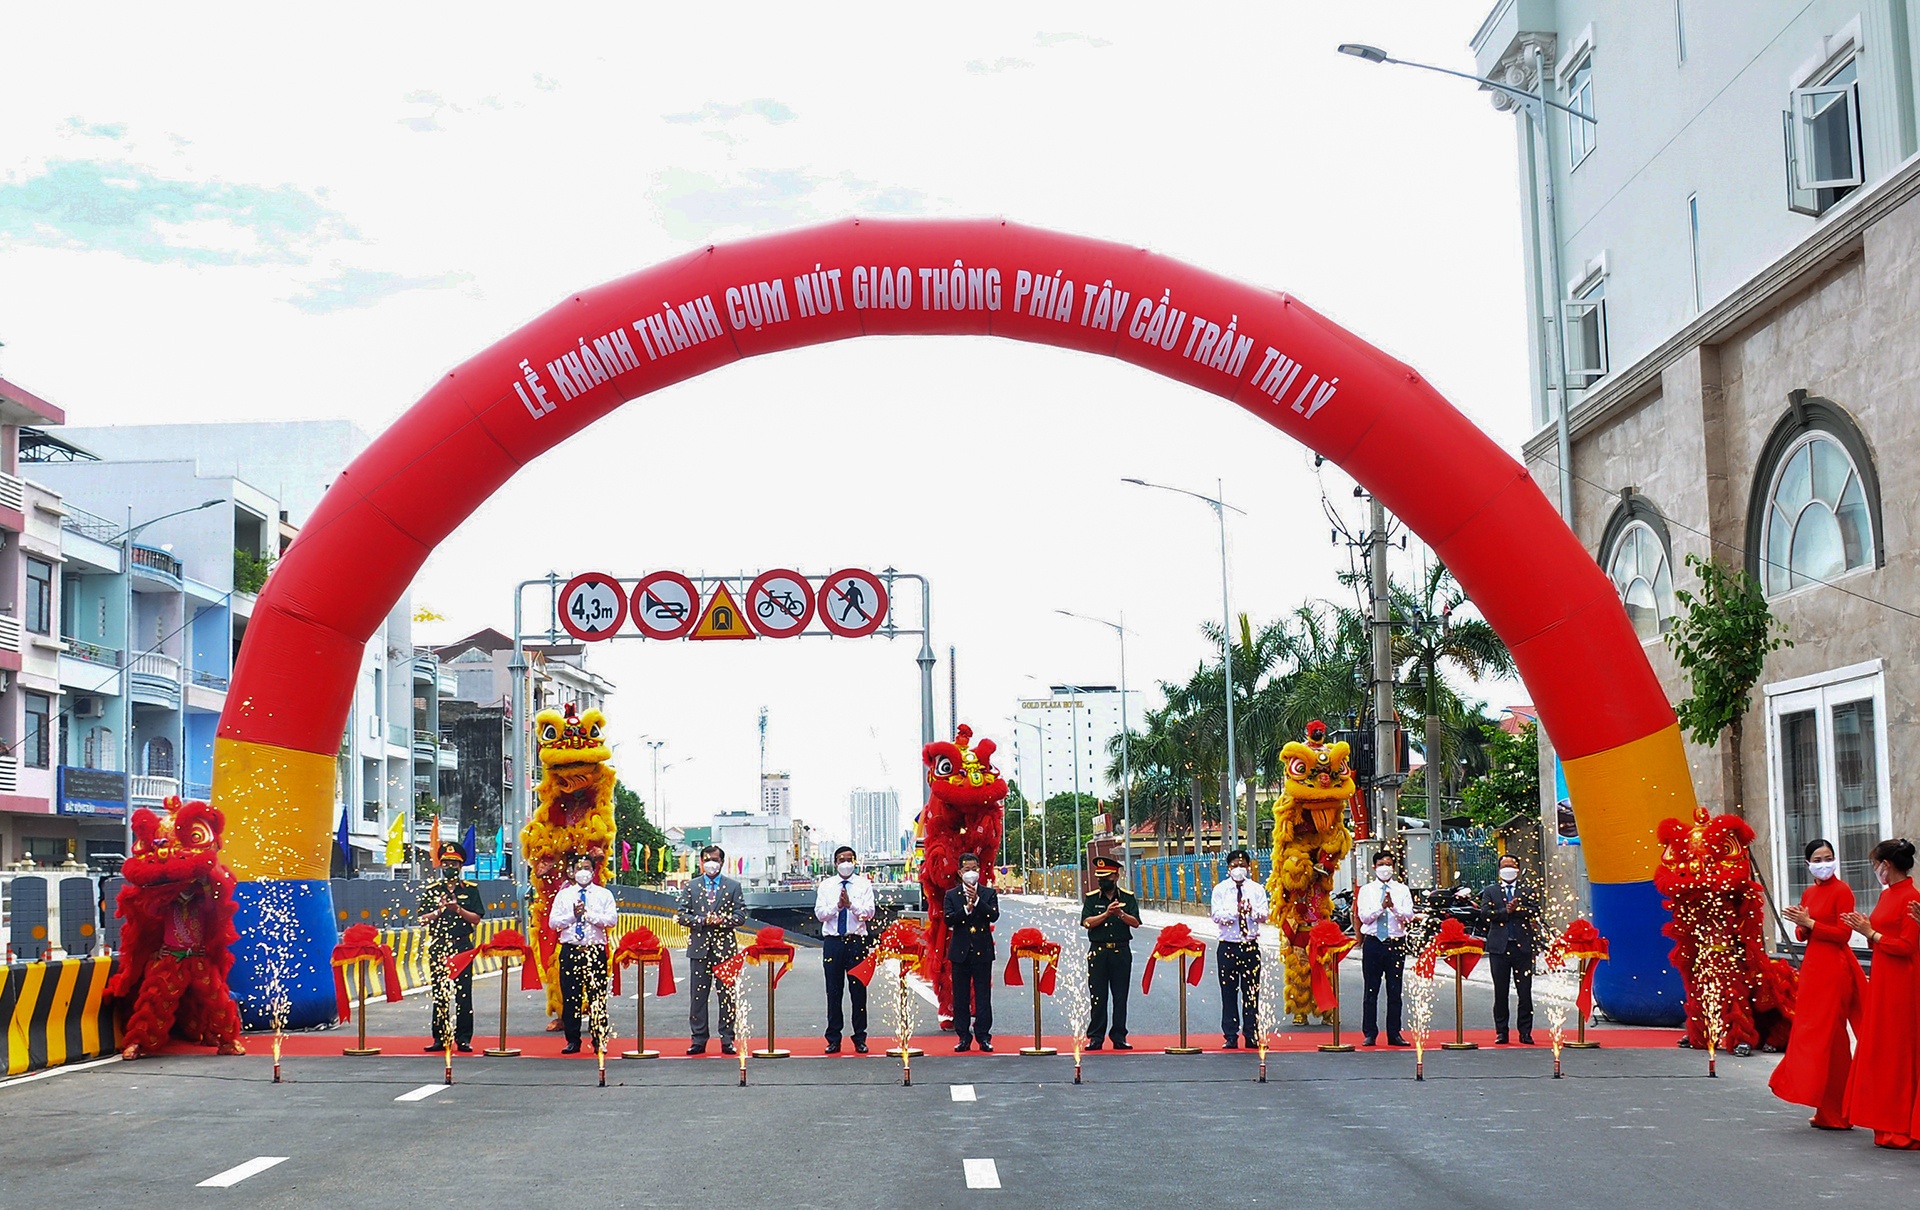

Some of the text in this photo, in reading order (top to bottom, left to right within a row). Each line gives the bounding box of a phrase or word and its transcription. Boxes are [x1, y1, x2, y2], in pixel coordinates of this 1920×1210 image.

[513, 260, 1340, 420] LỄ KHÁNH THÀNH CỤM NÚT GIAO THÔNG PHÍA TÂY CẦU TRẦN THỊ LÝ
[572, 593, 613, 624] 4,3m
